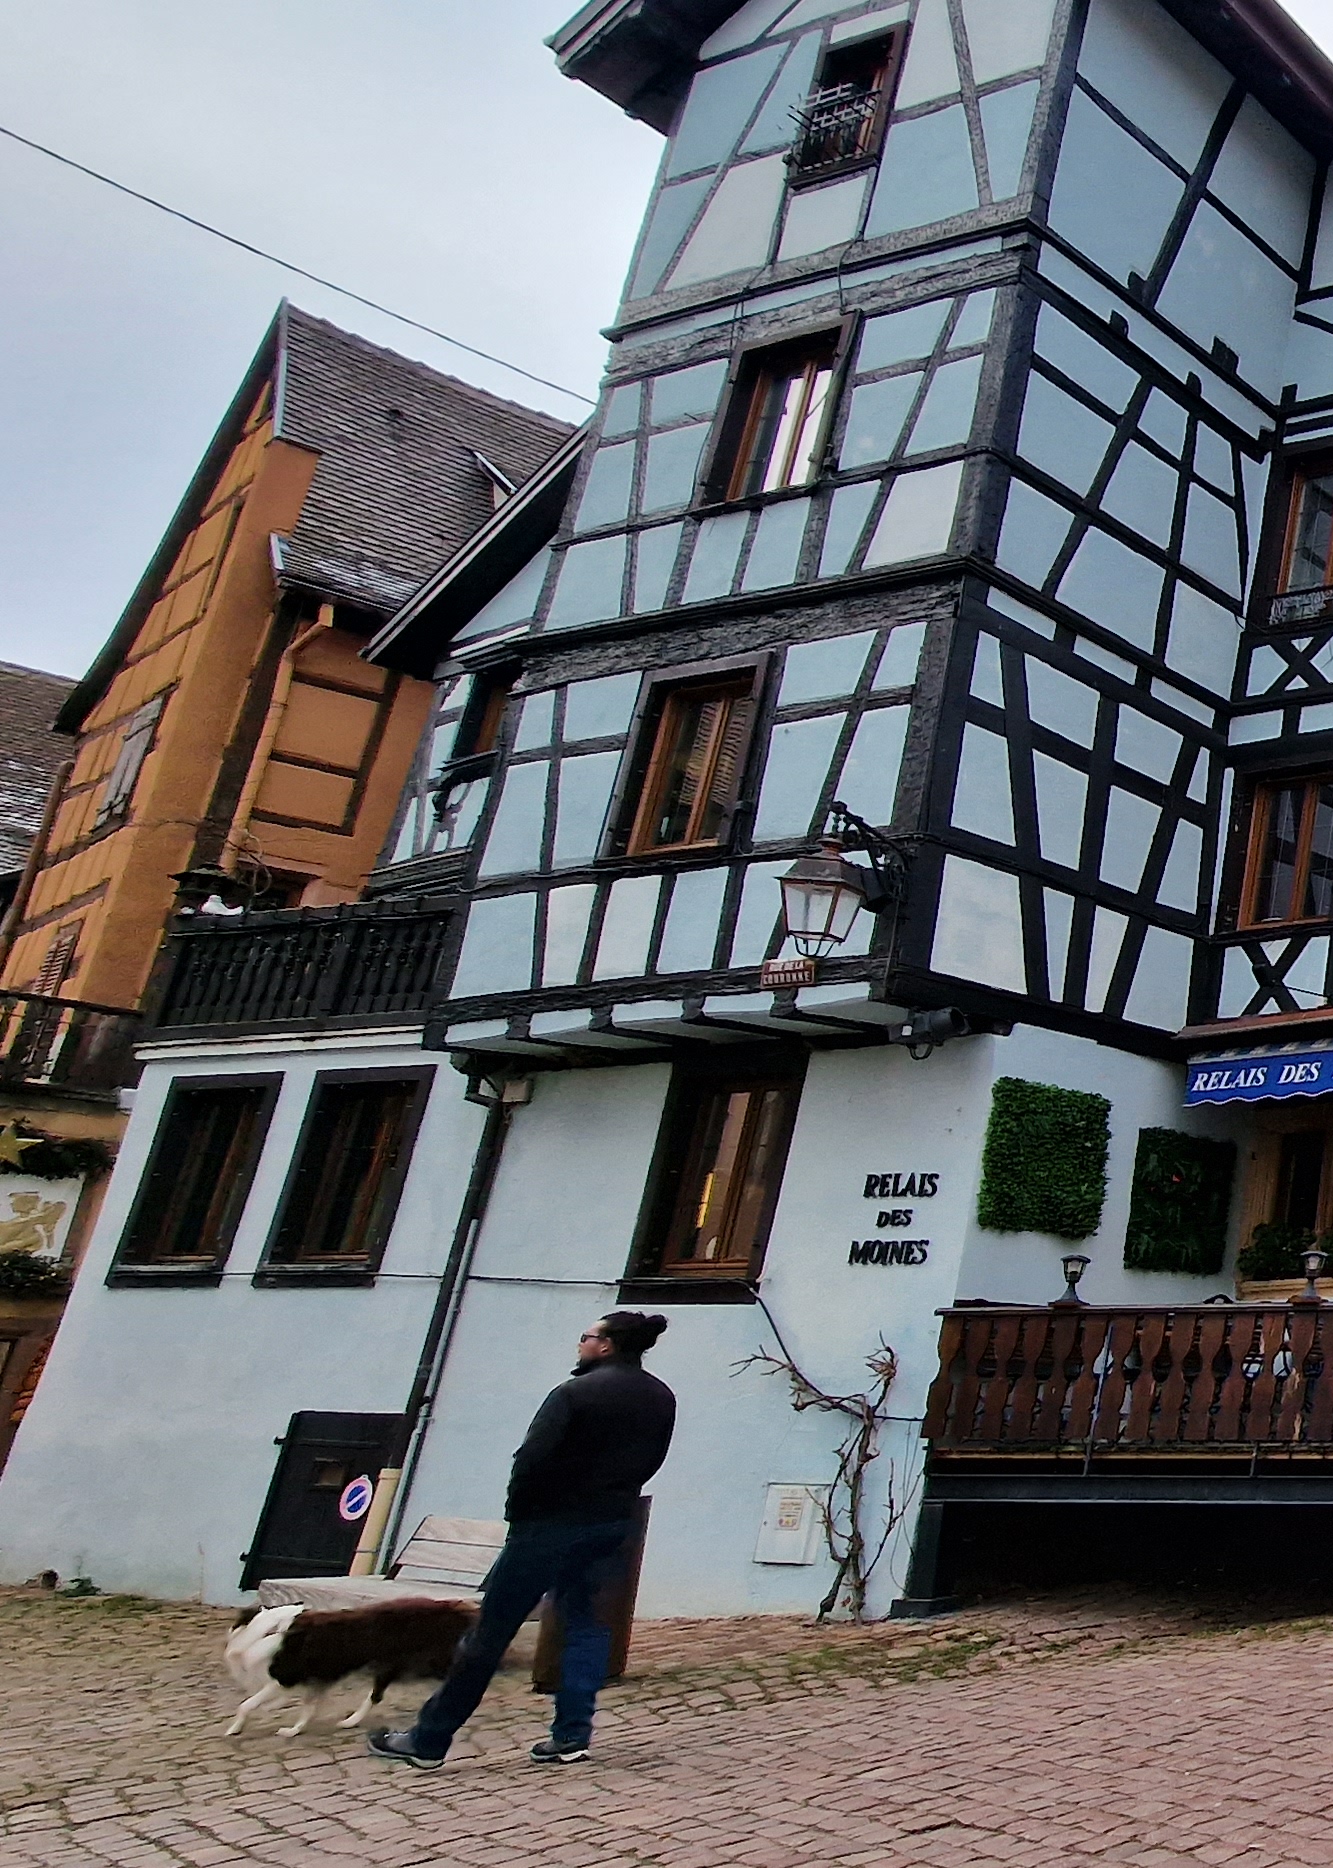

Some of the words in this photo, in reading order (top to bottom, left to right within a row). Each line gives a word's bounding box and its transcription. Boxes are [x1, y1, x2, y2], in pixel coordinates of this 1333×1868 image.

[763, 970, 811, 985] COURONNE
[1190, 1066, 1268, 1092] RELAIS
[1277, 1061, 1322, 1084] DES
[863, 1171, 940, 1198] RELAIS
[875, 1209, 914, 1228] DES
[847, 1239, 930, 1266] MOINES
